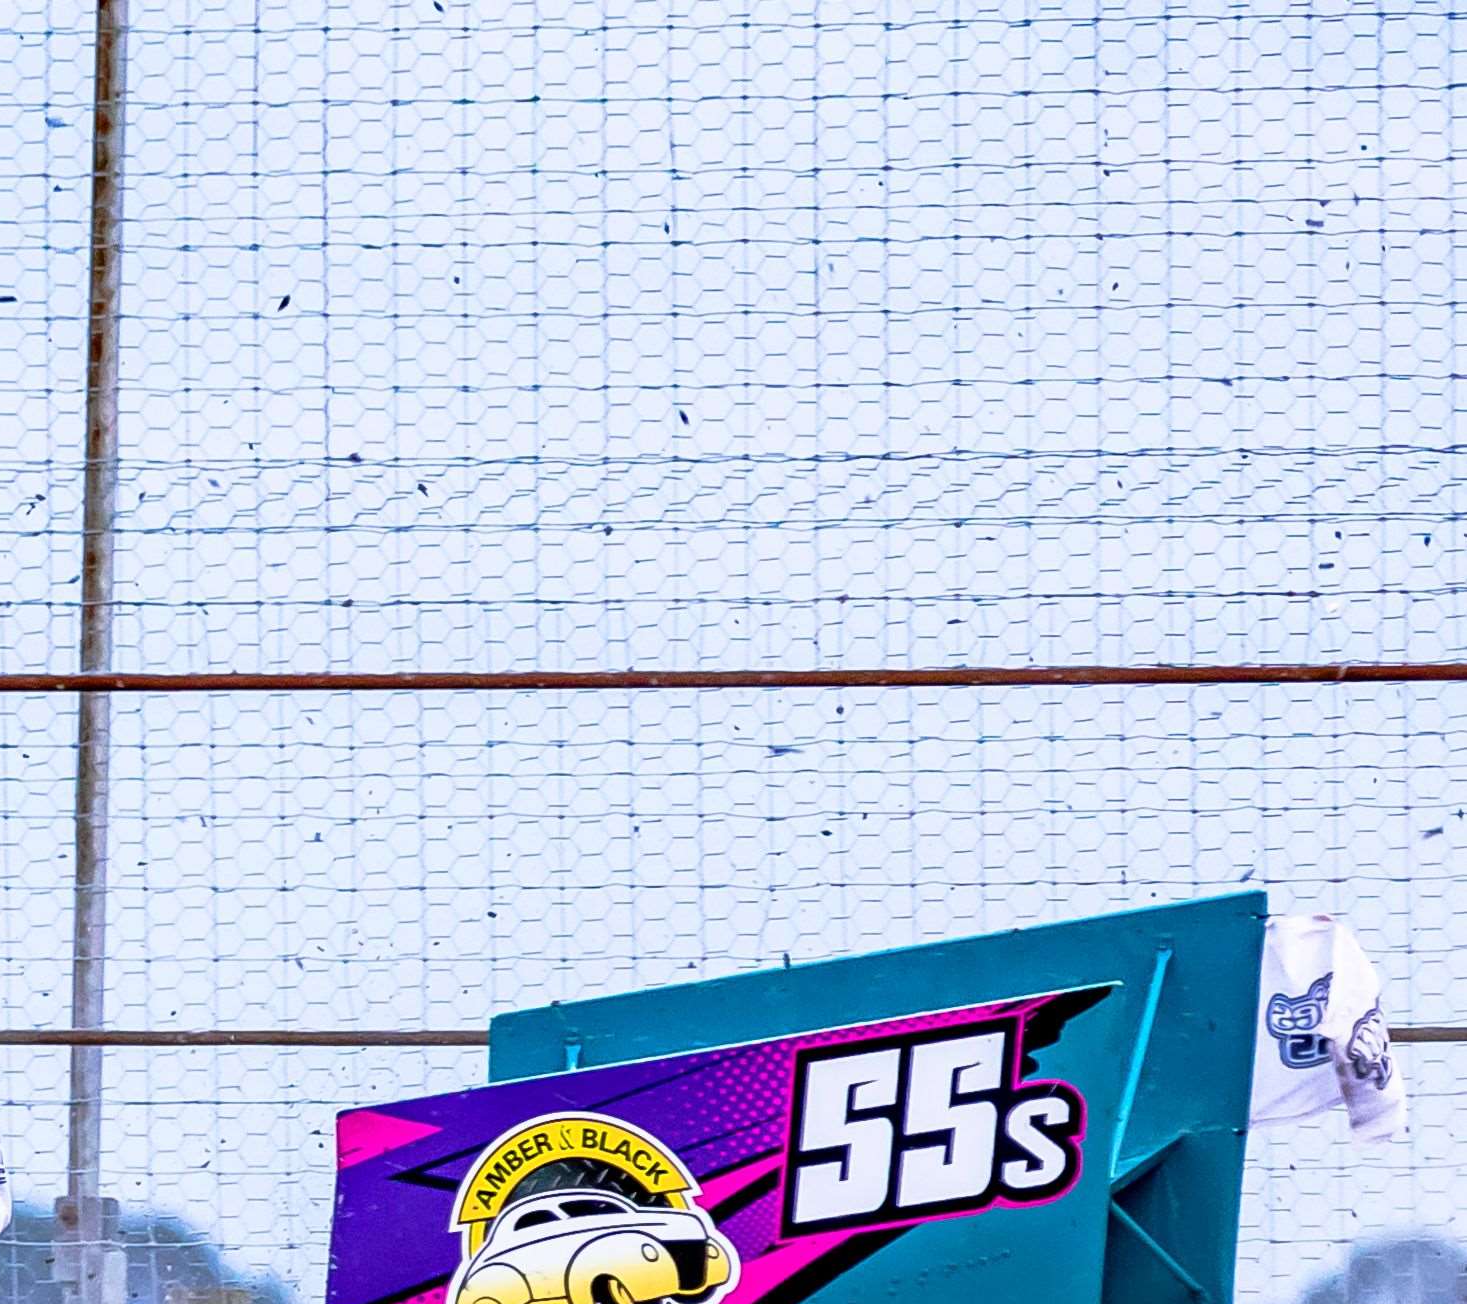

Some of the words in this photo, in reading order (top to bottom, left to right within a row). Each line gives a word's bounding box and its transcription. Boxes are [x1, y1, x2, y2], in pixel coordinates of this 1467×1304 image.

[480, 1133, 550, 1210] AMBER
[581, 1128, 670, 1186] BLACK
[793, 1032, 1069, 1224] 55s
